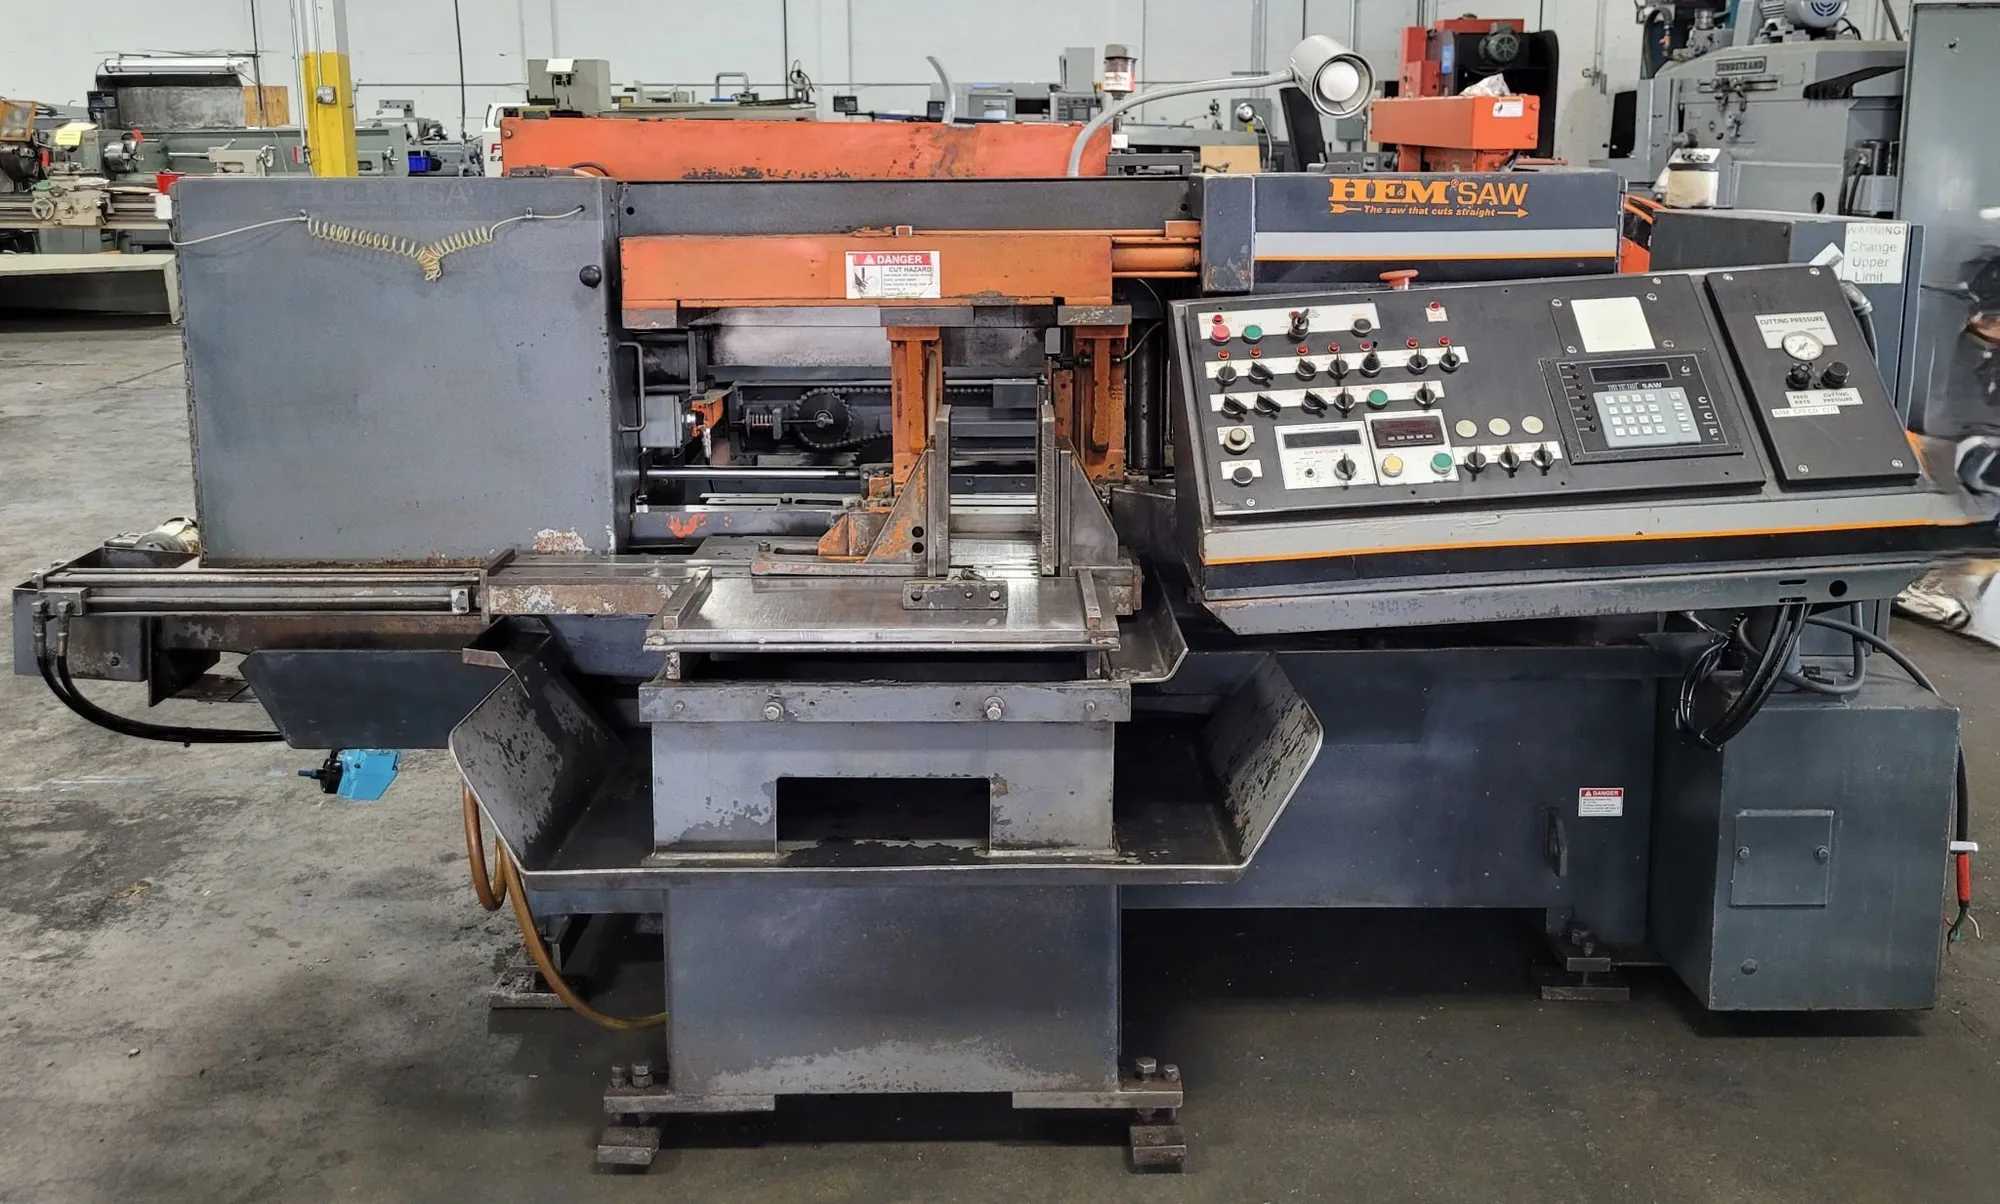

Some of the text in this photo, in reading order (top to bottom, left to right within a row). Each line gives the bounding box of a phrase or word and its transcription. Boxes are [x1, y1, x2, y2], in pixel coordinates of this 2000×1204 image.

[1457, 181, 1529, 206] SAW
[1364, 204, 1497, 219] The saw that cuts straight
[1849, 240, 1897, 255] Change
[876, 254, 923, 265] DANGER
[1852, 256, 1889, 269] Upper
[1854, 271, 1884, 282] Limit
[1790, 315, 1826, 323] PRESSURE
